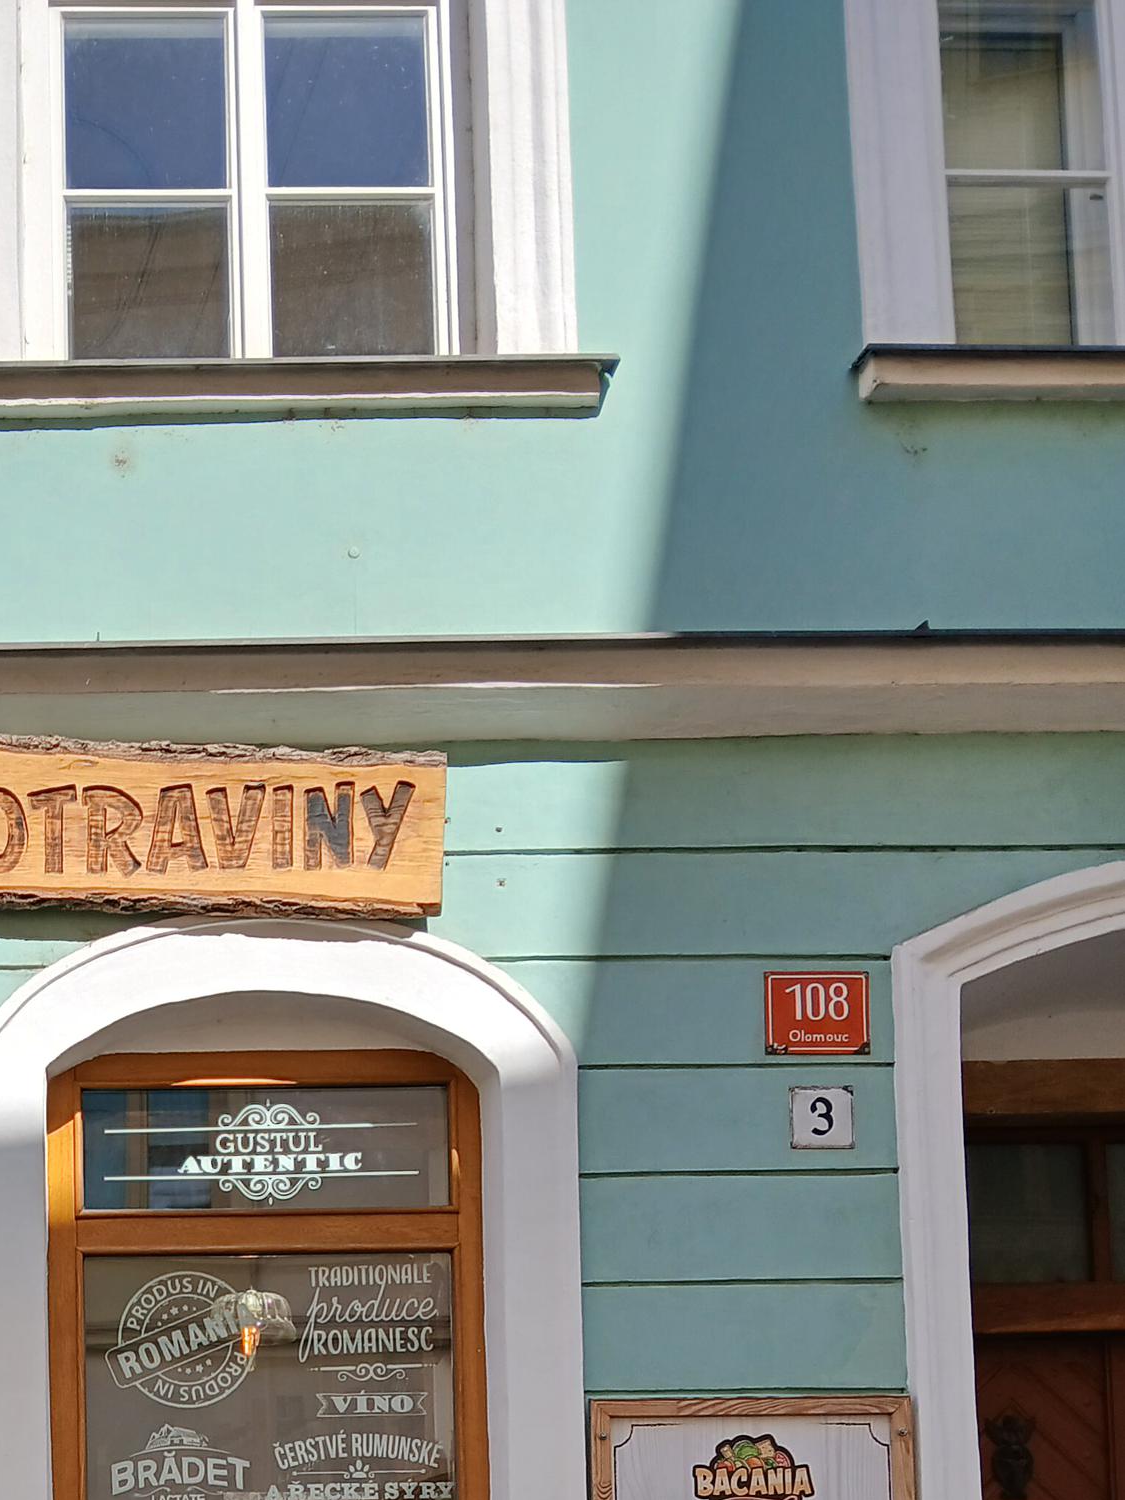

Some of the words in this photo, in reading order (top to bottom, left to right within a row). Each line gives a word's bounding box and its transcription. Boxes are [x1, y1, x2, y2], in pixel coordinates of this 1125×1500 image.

[785, 982, 850, 1021] 108
[789, 1030, 849, 1043] Olomouc
[810, 1096, 834, 1136] 3
[215, 1131, 323, 1154] GUSTUL
[177, 1152, 363, 1174] AUTENTIC
[308, 1264, 432, 1287] TRADITIONALE
[127, 1278, 193, 1331] PRODUS
[197, 1279, 219, 1298] IN
[298, 1280, 438, 1364] produce
[312, 1327, 434, 1355] ROMANESC
[331, 1390, 414, 1414] VÍNO
[274, 1430, 347, 1470] ČERSTVÉ
[352, 1432, 444, 1470] RUMUNSKÉ
[384, 1478, 456, 1500] SÝRY
[695, 1466, 814, 1496] BACANIA
